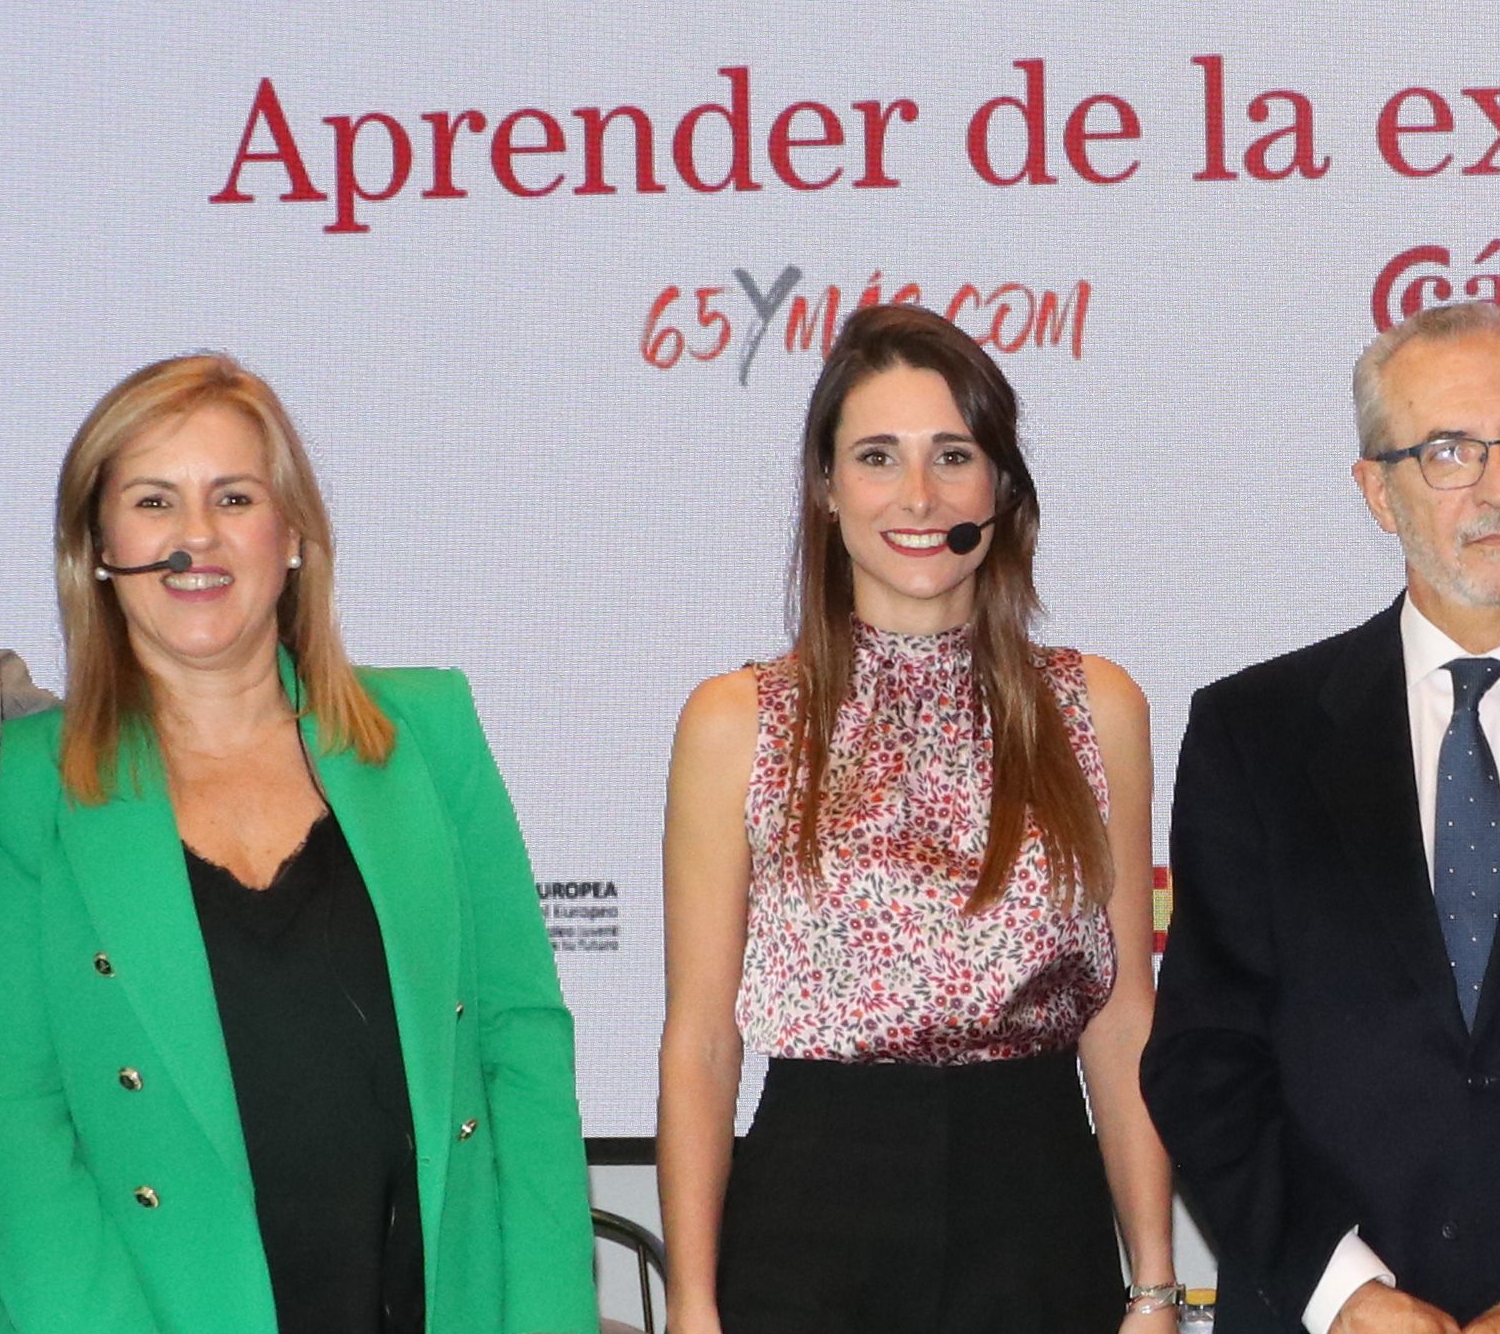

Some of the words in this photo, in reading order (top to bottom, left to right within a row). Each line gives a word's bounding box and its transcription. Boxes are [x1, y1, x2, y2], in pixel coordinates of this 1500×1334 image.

[209, 66, 919, 234] Aprender
[966, 58, 1141, 187] de
[1191, 53, 1331, 182] la
[535, 880, 618, 899] UROPEA
